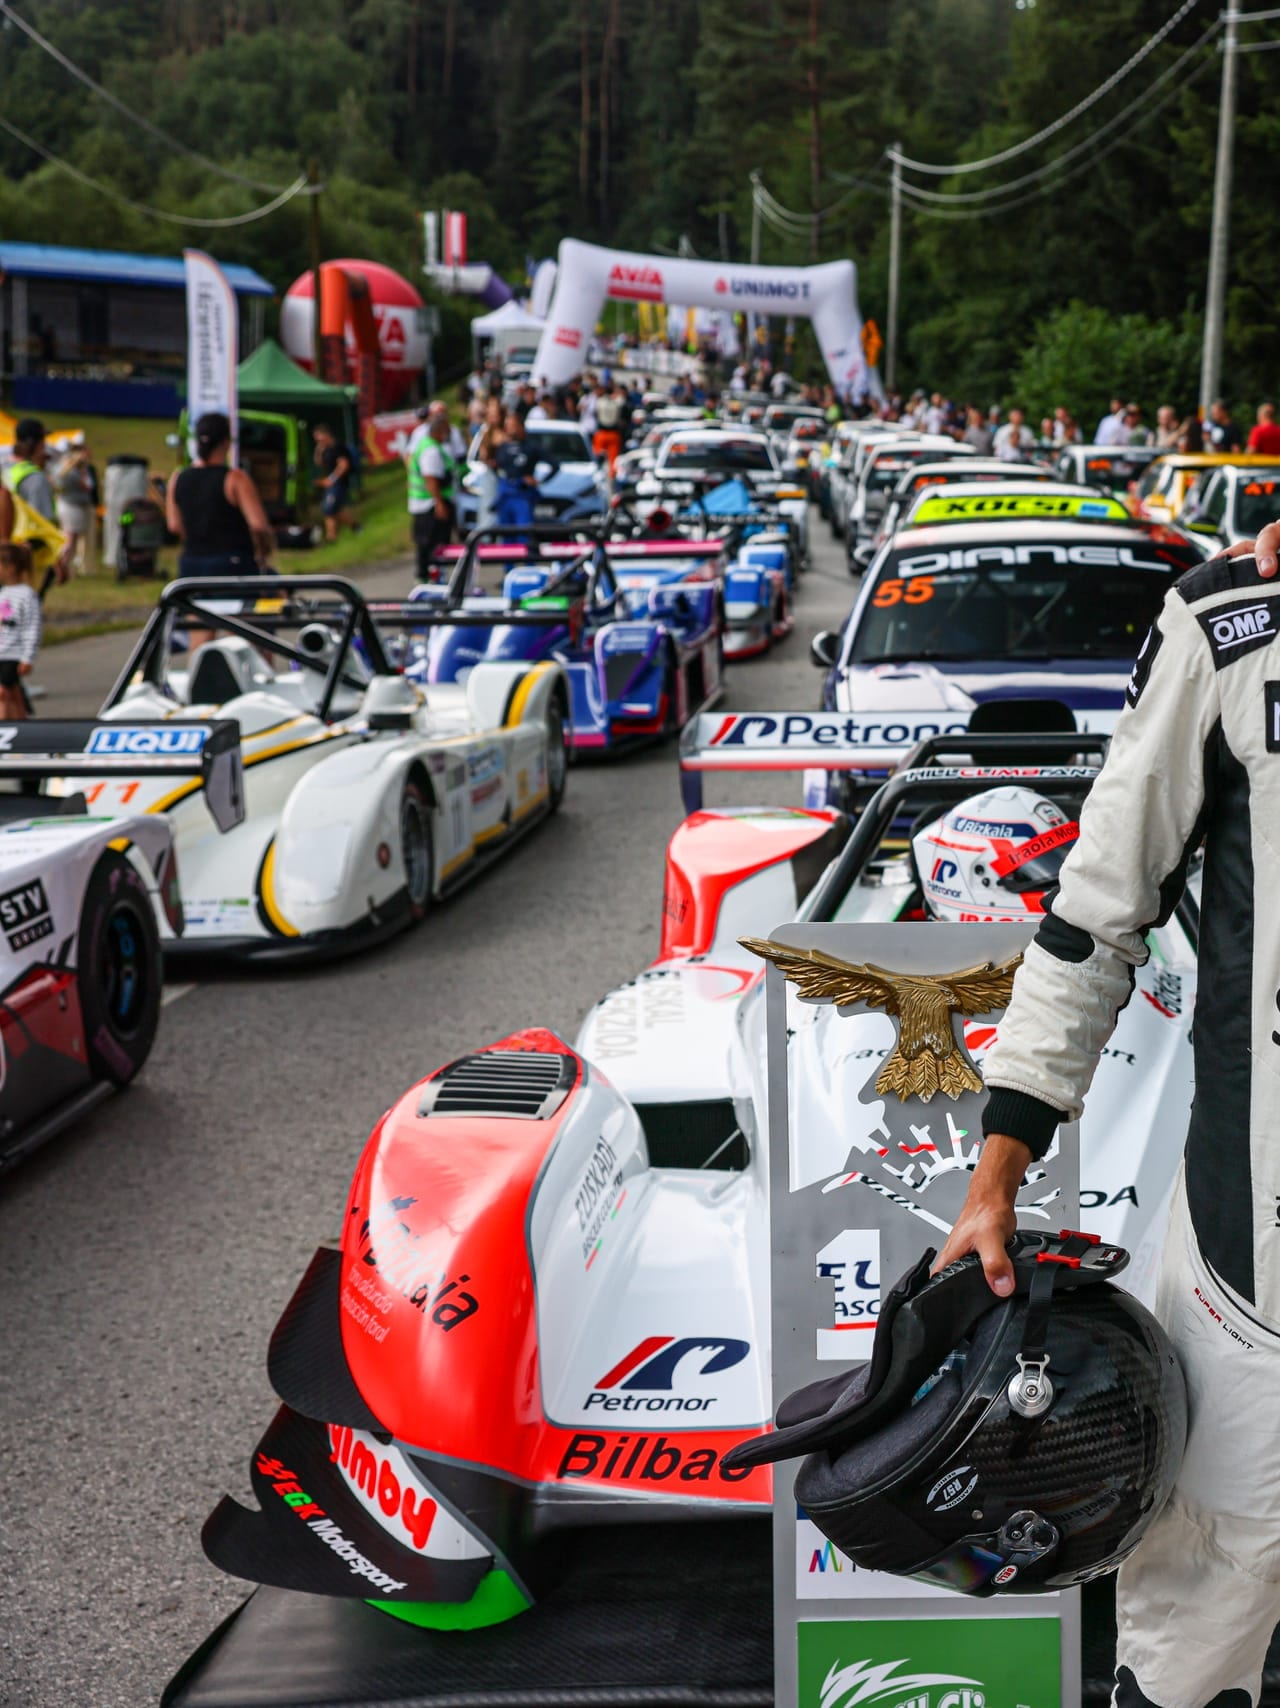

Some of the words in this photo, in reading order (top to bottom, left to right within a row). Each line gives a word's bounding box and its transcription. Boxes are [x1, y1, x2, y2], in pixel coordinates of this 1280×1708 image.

[731, 279, 811, 299] UNIMOT
[872, 575, 935, 608] 55
[1212, 608, 1272, 644] OMP
[95, 730, 202, 753] LIQUI
[965, 821, 1014, 838] Bizkaia
[1008, 836, 1053, 866] Iraola
[0, 886, 43, 924] STV
[1222, 1323, 1254, 1351] LIGHT
[582, 1392, 718, 1412] Petronor
[306, 1518, 409, 1594] Motorsport
